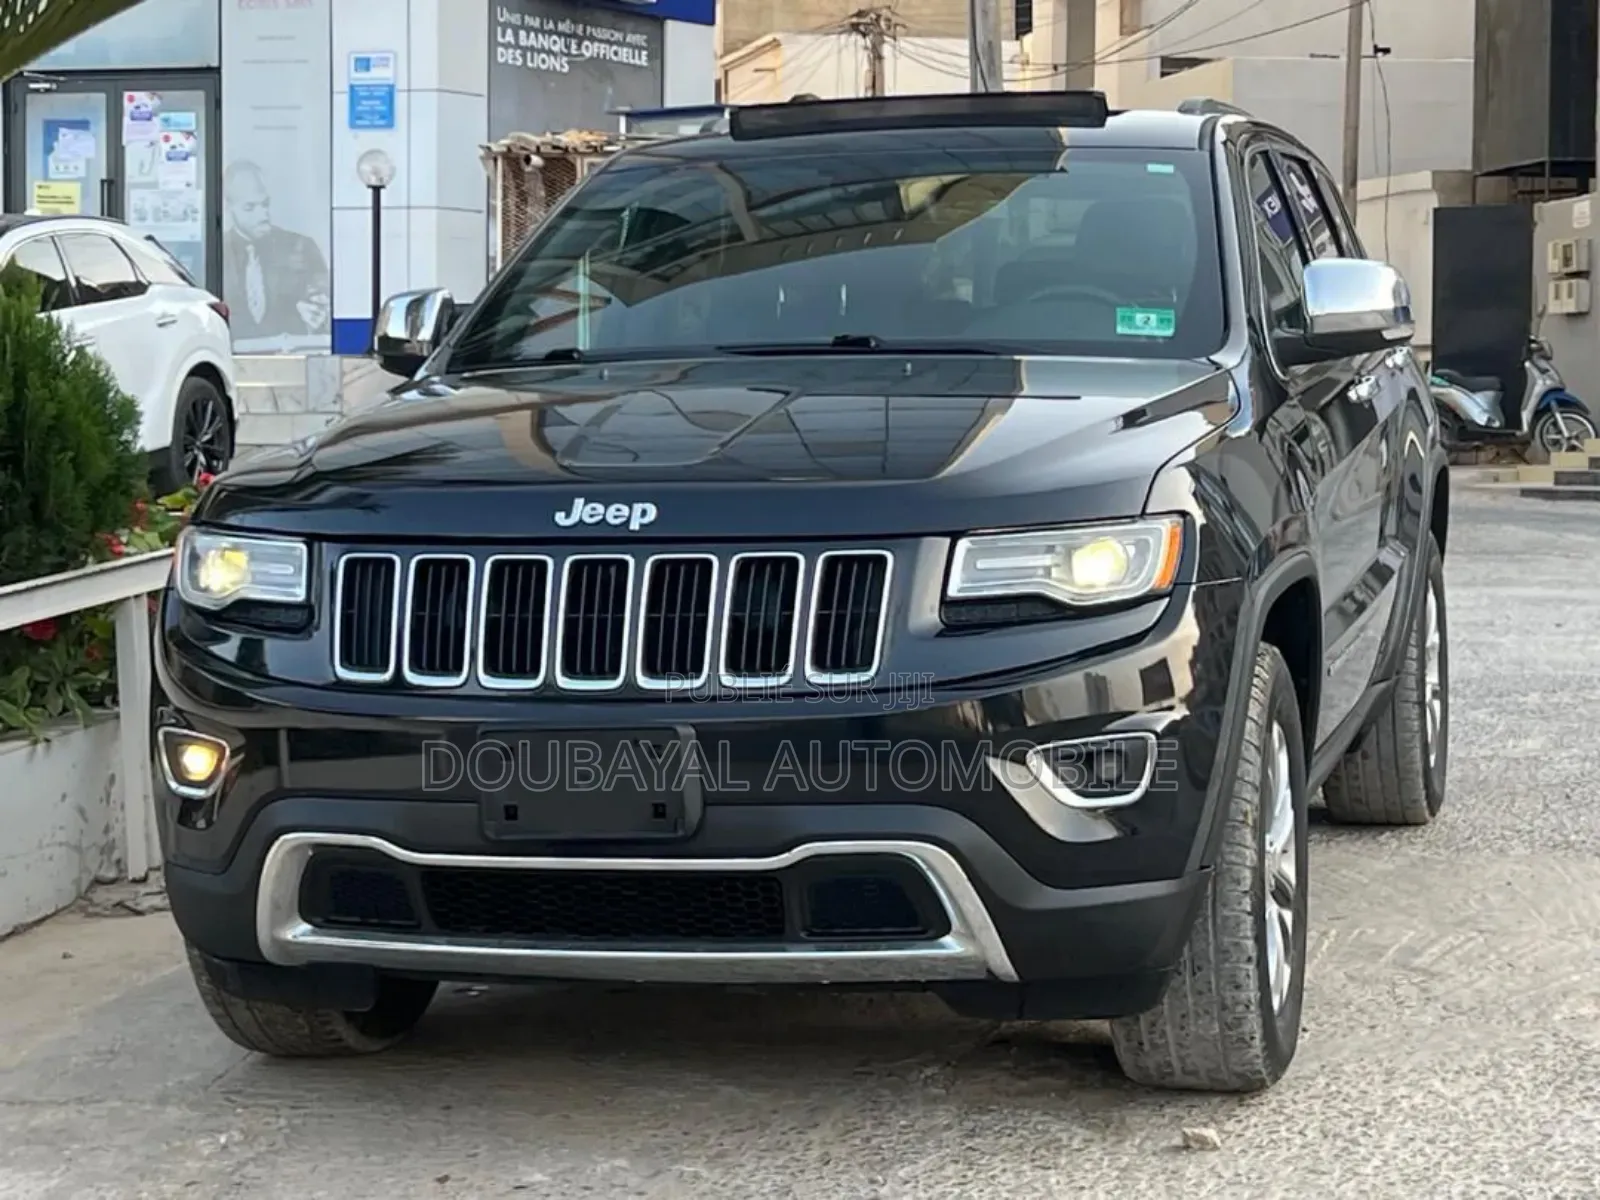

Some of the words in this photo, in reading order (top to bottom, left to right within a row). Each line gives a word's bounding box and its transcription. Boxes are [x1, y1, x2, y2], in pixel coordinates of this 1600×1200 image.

[497, 26, 515, 45] LA
[581, 40, 648, 67] OFFICIELLE
[524, 13, 541, 29] PAR
[543, 17, 555, 31] LA
[586, 25, 624, 42] PASSION
[626, 32, 648, 47] AVEC
[497, 46, 523, 66] DES
[527, 51, 570, 73] LIONS
[554, 497, 657, 531] Jeep
